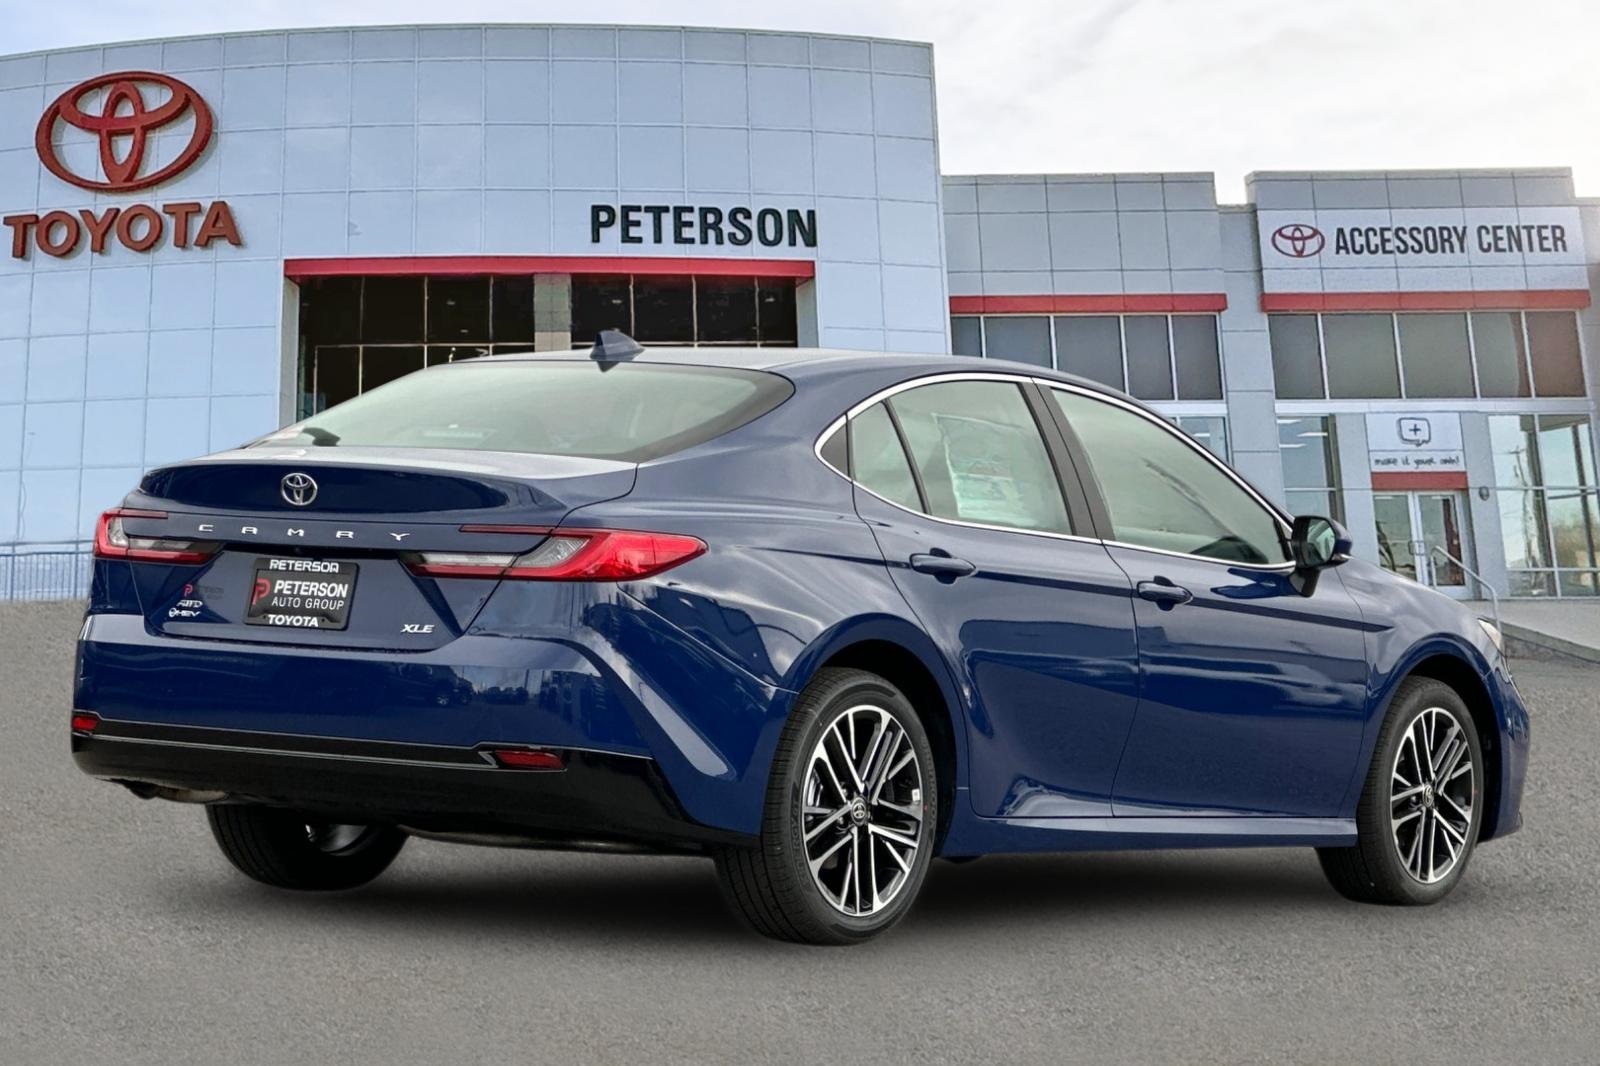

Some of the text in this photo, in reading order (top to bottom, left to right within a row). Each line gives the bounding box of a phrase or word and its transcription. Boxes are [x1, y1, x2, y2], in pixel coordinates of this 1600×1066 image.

[3, 201, 242, 258] TOYOTA
[591, 205, 818, 247] PETERSON
[1335, 225, 1568, 255] ACCESSORY CENTER
[1402, 456, 1411, 465] it
[198, 523, 410, 541] CAMRY
[273, 579, 349, 598] PETERSON
[271, 596, 345, 610] AUTO GROUP
[267, 614, 319, 627] TOYOTA
[401, 623, 435, 634] XLE
